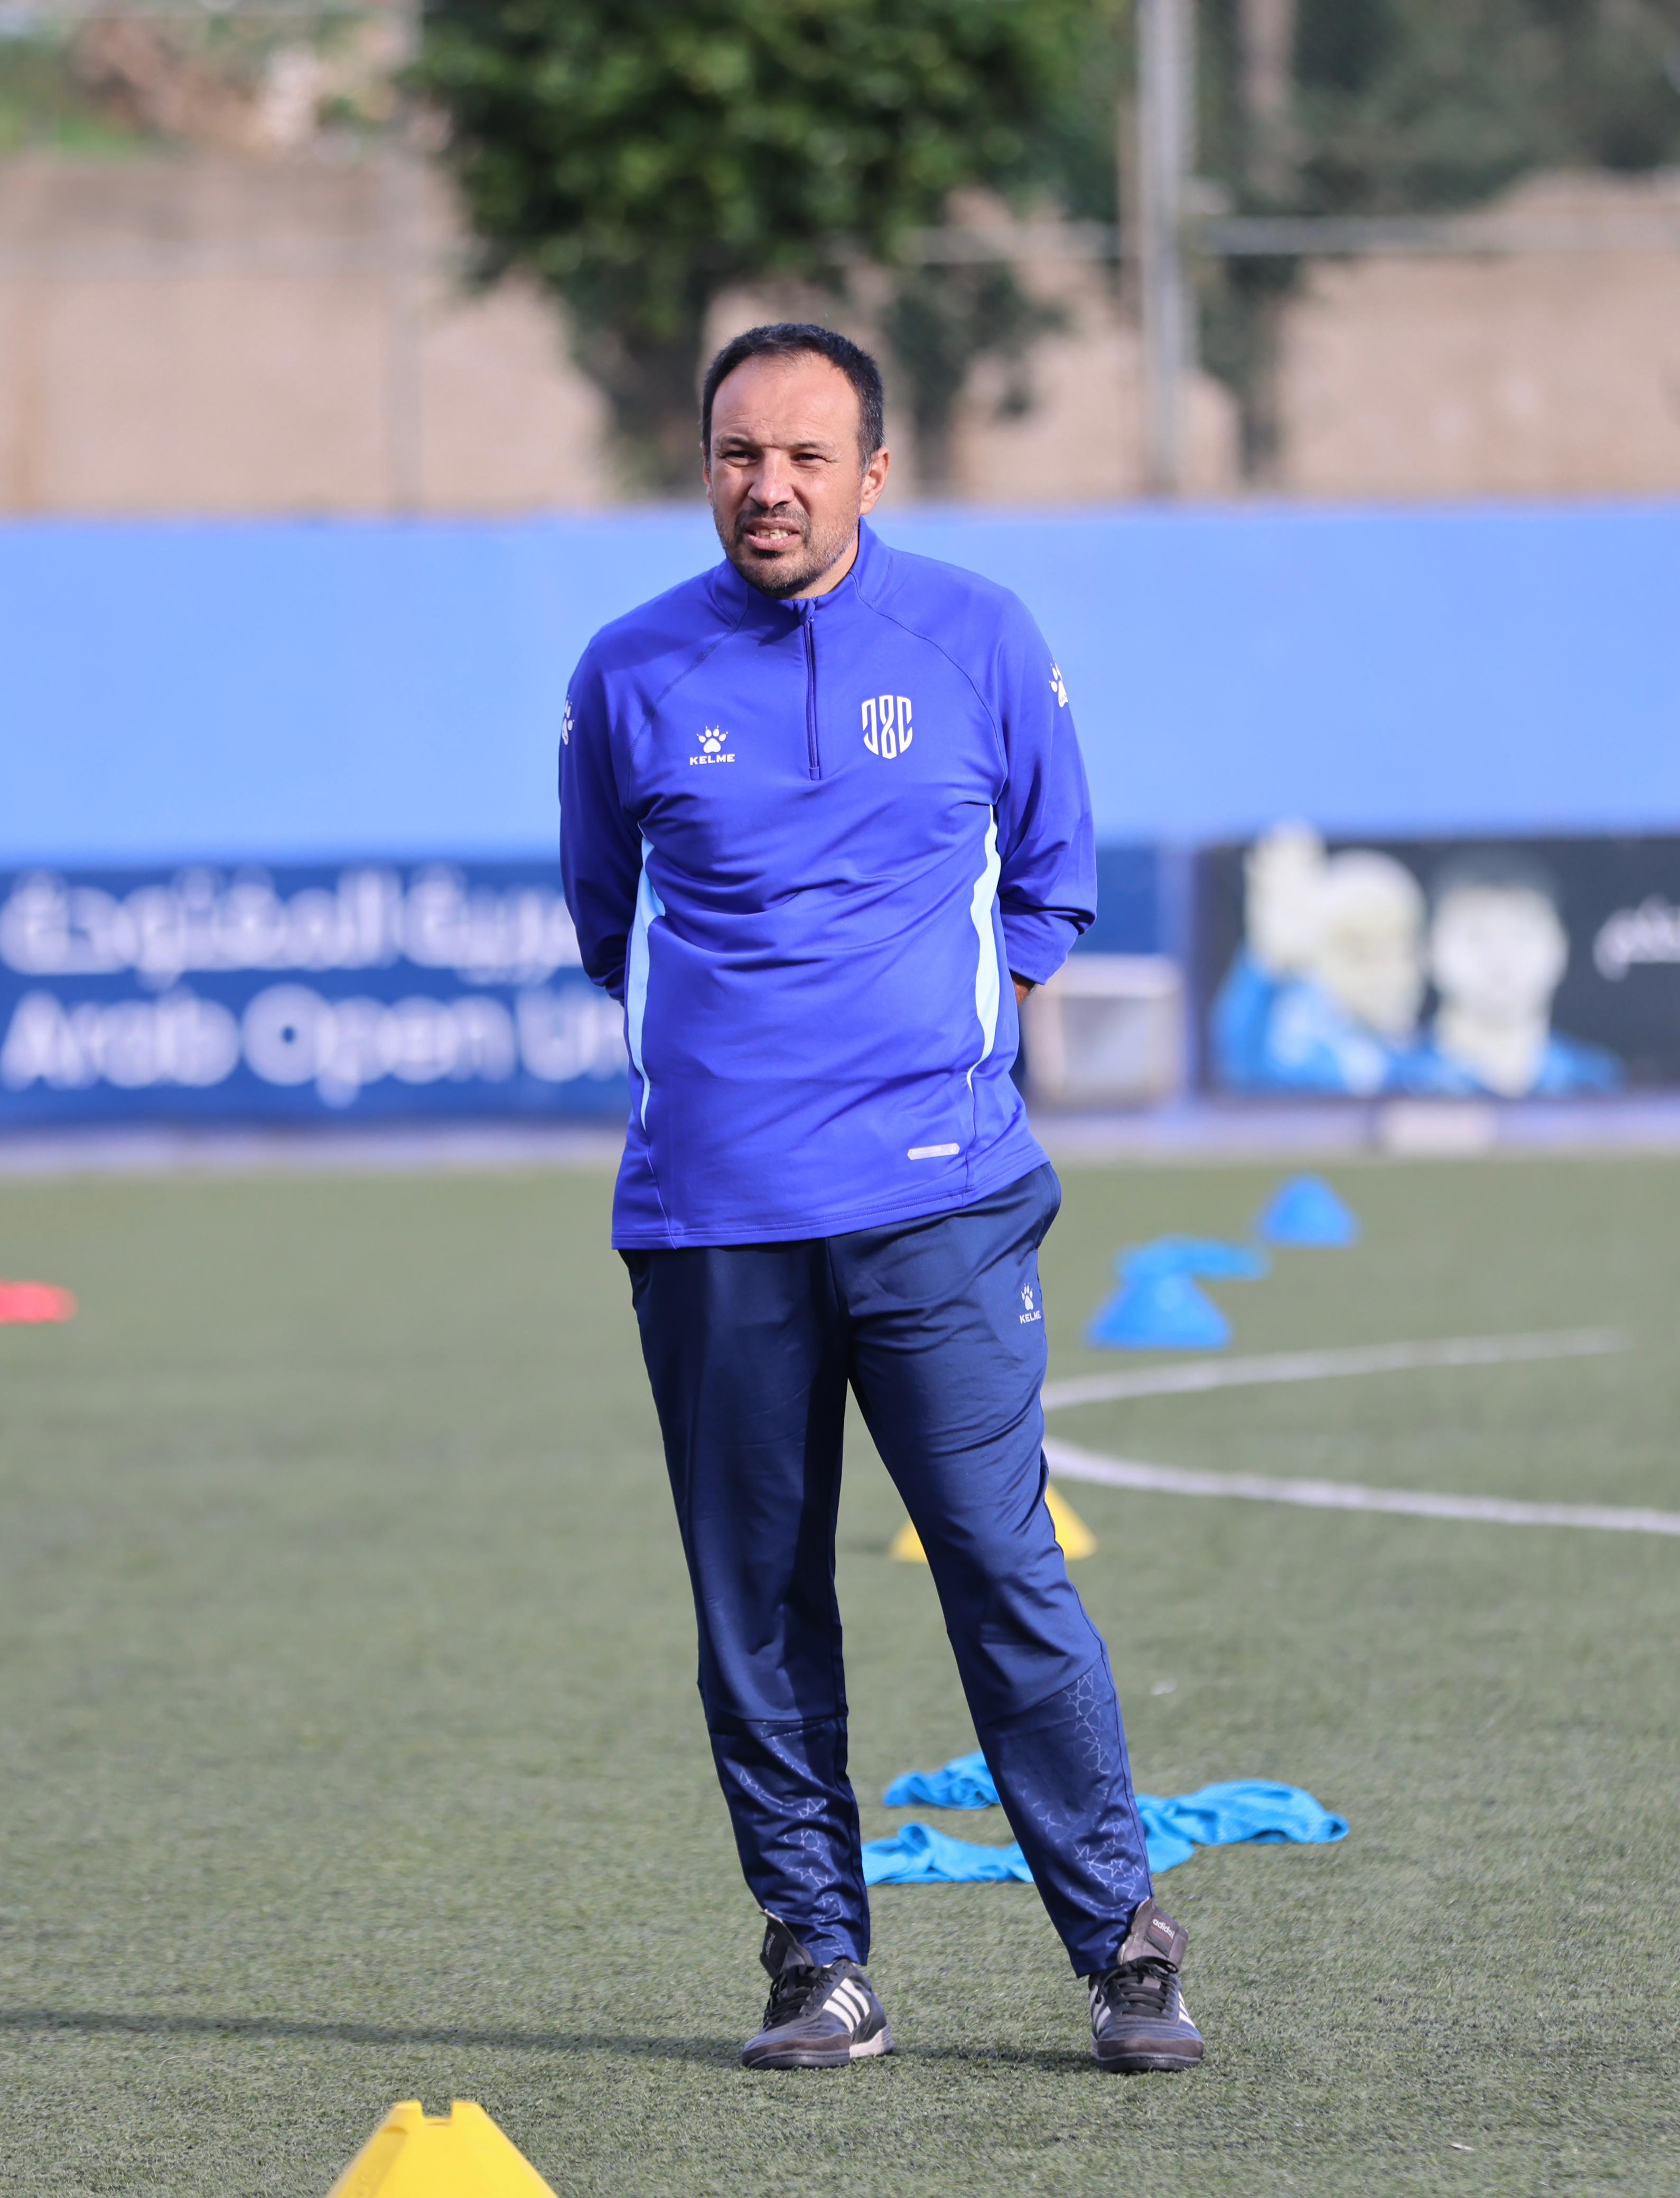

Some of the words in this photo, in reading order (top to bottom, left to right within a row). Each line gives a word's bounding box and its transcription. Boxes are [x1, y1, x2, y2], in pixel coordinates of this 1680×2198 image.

[689, 753, 735, 766] KELME
[3, 990, 239, 1091] Arab
[242, 983, 517, 1110] Open
[1019, 1310, 1041, 1324] KELME
